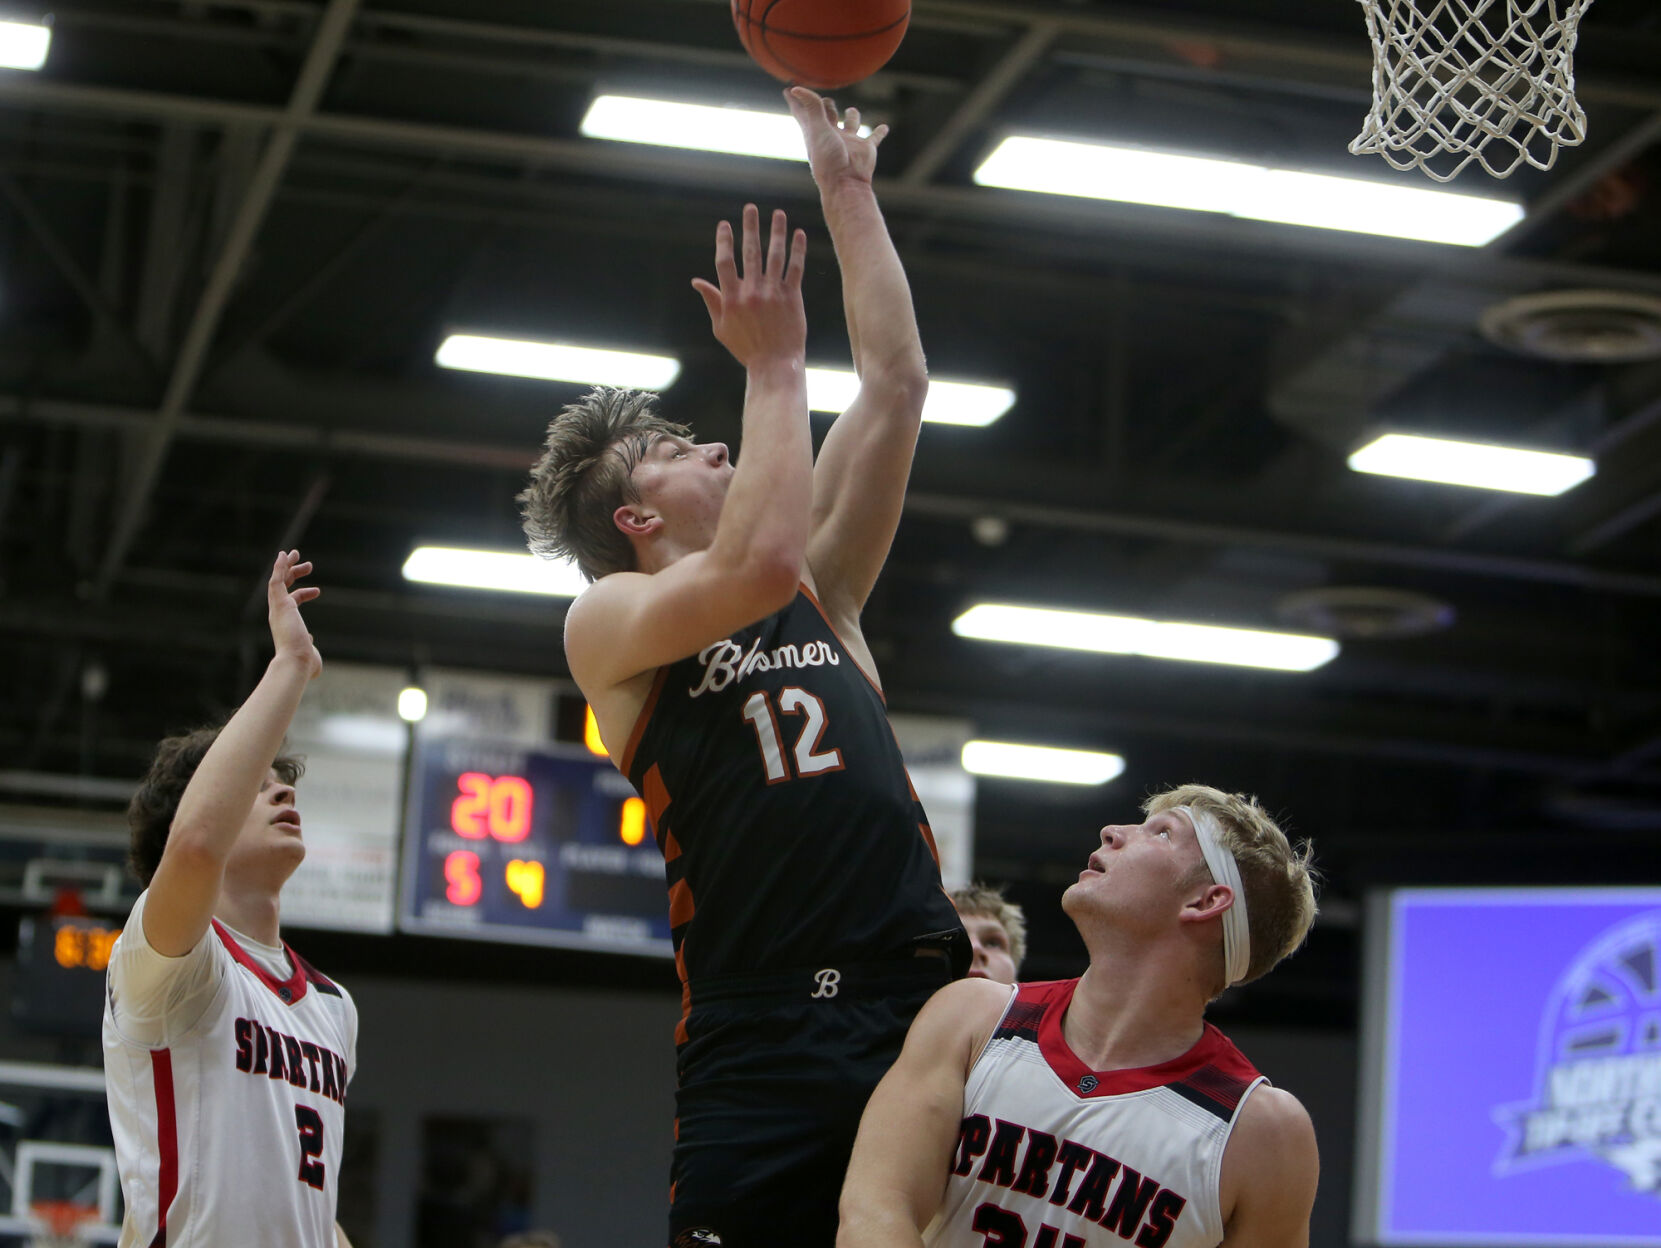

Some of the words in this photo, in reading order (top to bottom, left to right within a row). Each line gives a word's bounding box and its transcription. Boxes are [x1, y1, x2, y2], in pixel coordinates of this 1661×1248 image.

[741, 686, 846, 786] 12
[451, 771, 533, 843] 20
[443, 849, 483, 907] 5
[235, 1016, 347, 1107] SPARTAN
[295, 1103, 325, 1192] 2
[951, 1113, 1187, 1248] PARTANS
